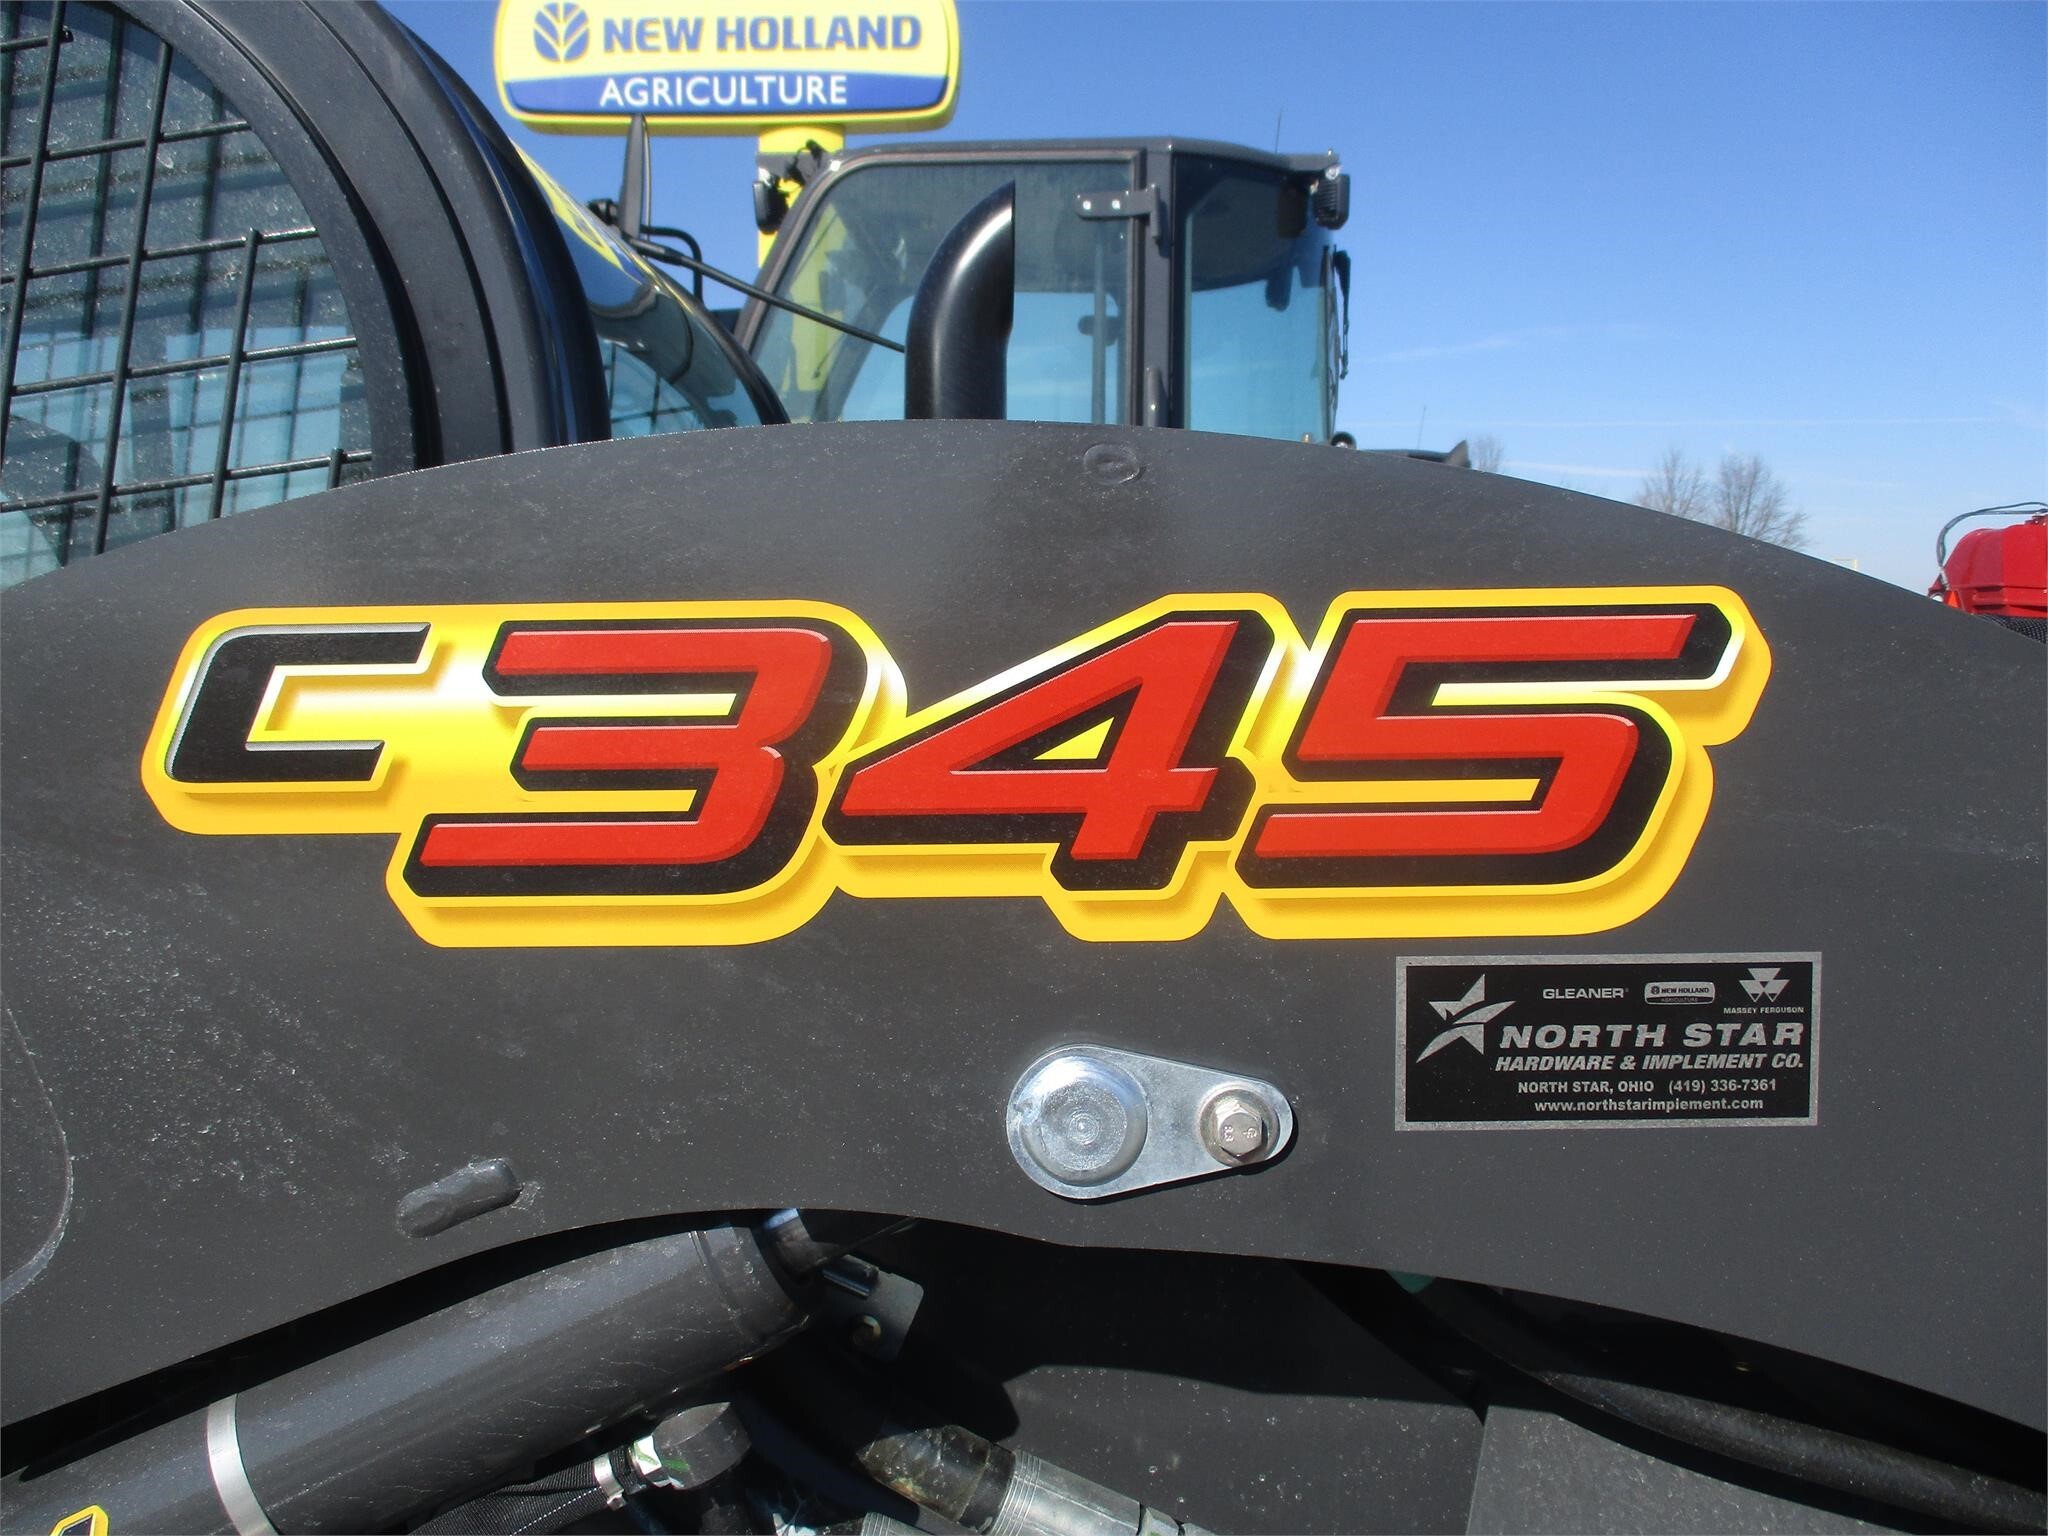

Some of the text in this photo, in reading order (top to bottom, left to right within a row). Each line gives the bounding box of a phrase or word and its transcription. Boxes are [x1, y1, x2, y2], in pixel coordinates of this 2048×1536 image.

[602, 15, 923, 53] NEW HOLLAND
[600, 74, 848, 107] AGRICULTURE
[1542, 987, 1625, 999] GLEANER
[1760, 1006, 1805, 1014] FERGUSON
[1499, 1022, 1805, 1049] NORTH STAR
[1494, 1052, 1804, 1072] HARDWARE & IMPLEMENT CO.
[1518, 1078, 1777, 1095] NORTH STAR, OHIO (419) 336-7361
[1534, 1098, 1764, 1114] www.northstarimplement.com
